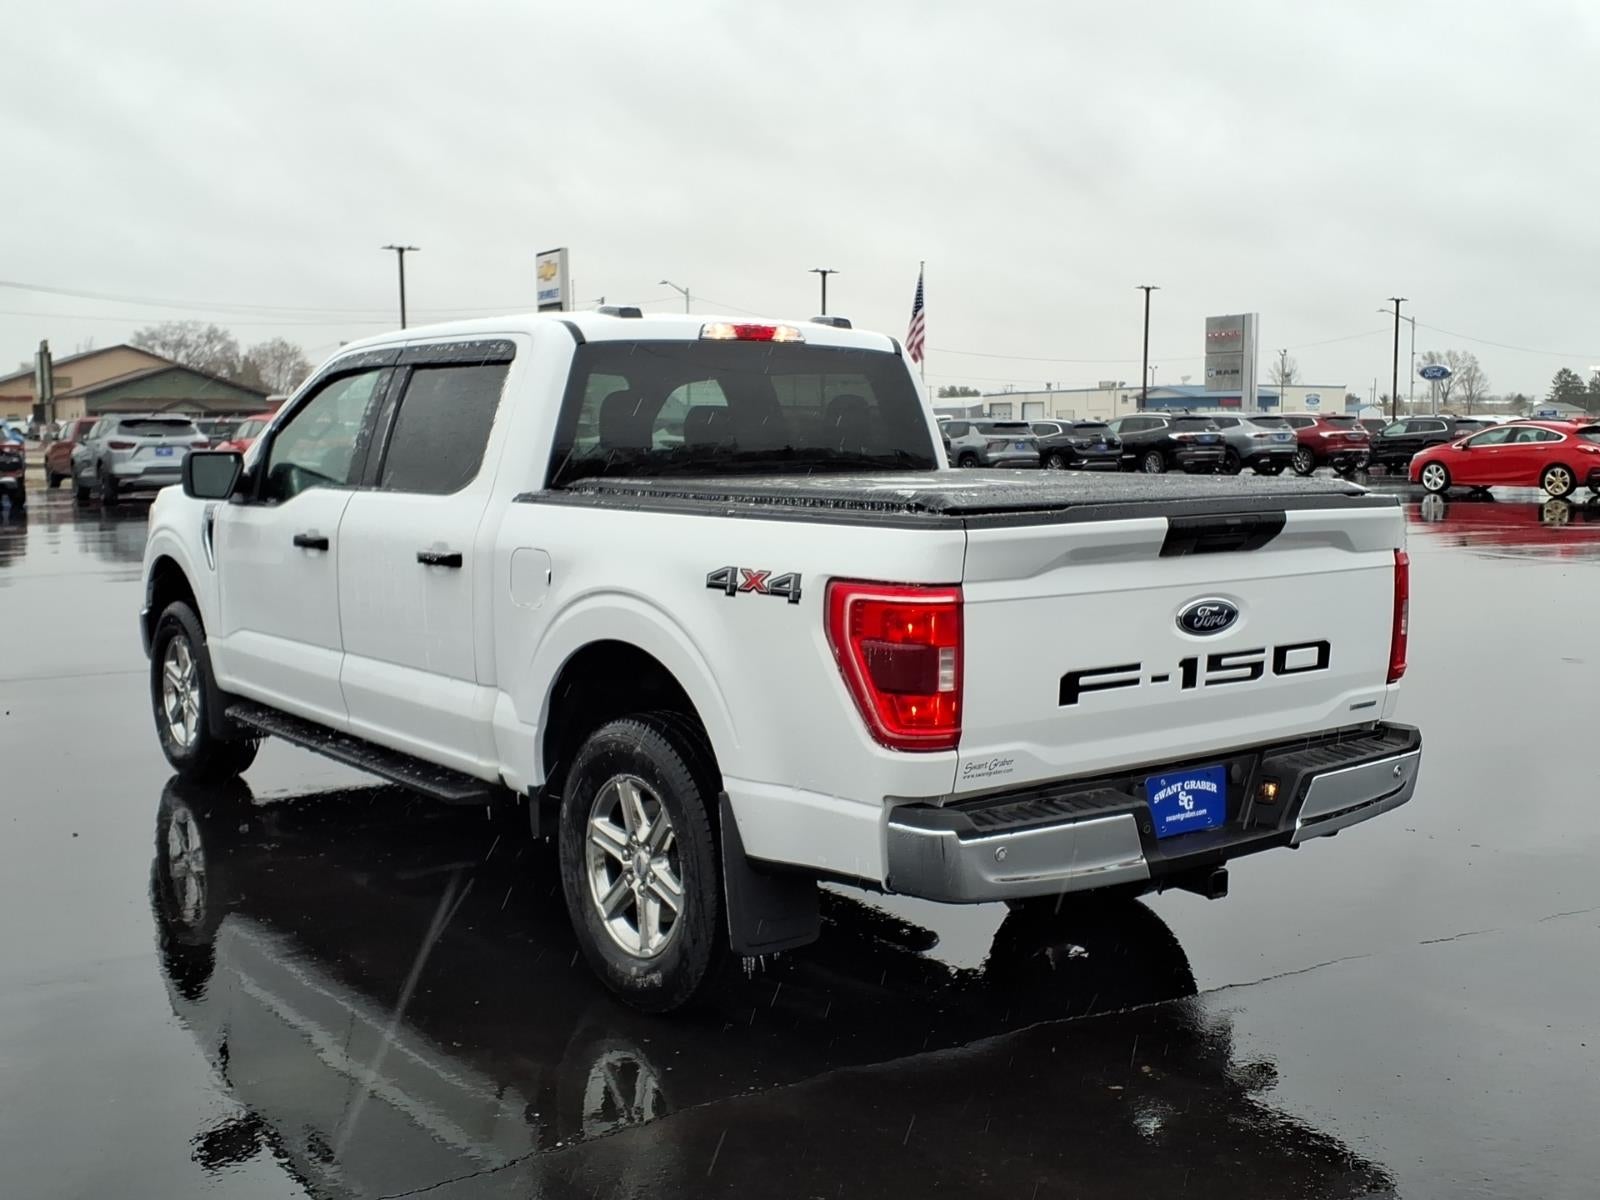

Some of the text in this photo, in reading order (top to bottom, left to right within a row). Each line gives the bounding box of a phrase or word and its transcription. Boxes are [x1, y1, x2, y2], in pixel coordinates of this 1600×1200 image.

[1193, 605, 1228, 628] Ford
[1058, 639, 1331, 707] F-150
[988, 758, 1014, 771] Graber
[1153, 780, 1218, 804] SWANT GRABER
[1178, 791, 1194, 810] SG
[1165, 808, 1207, 822] swantgraber.com
